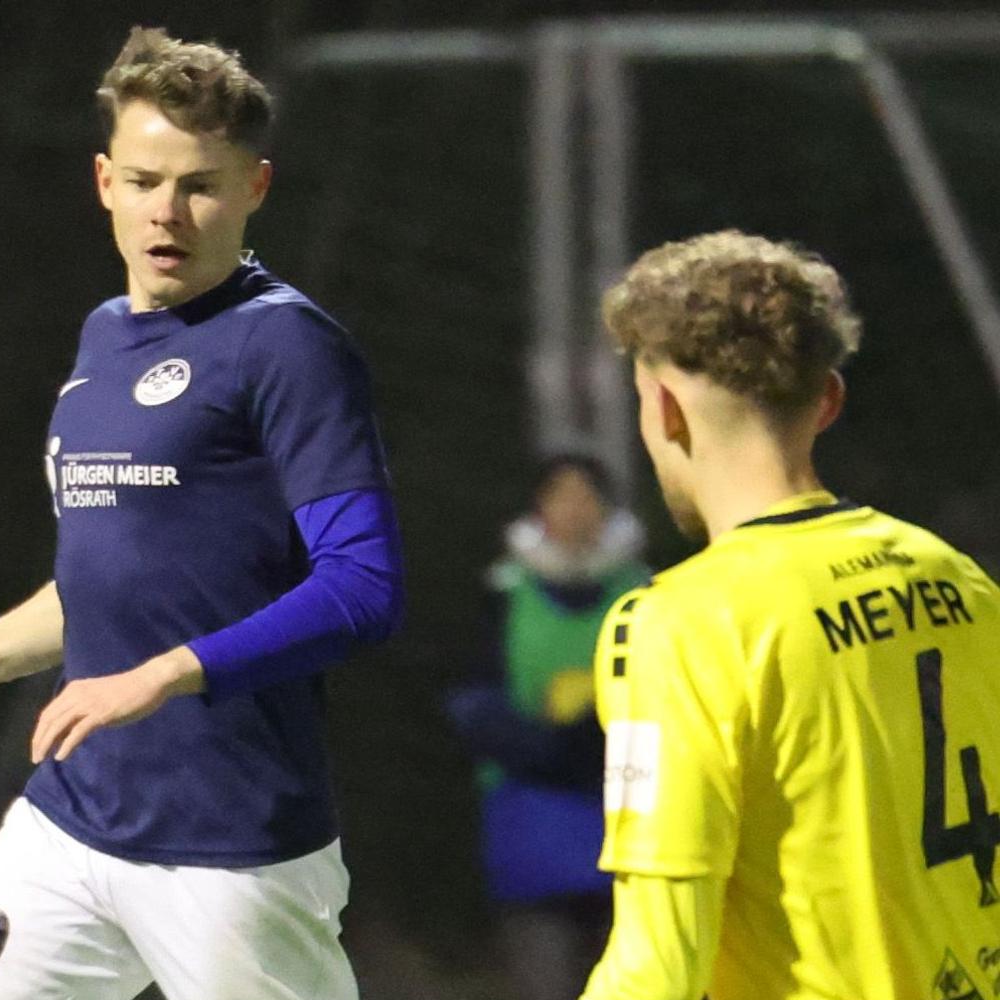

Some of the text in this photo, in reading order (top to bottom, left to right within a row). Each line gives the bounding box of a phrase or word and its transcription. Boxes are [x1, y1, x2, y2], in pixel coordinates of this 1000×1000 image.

[62, 462, 180, 489] JÜRGEN MEIER
[63, 487, 117, 508] RÖSRATH
[815, 578, 973, 654] MEYER
[916, 647, 1000, 908] 4
